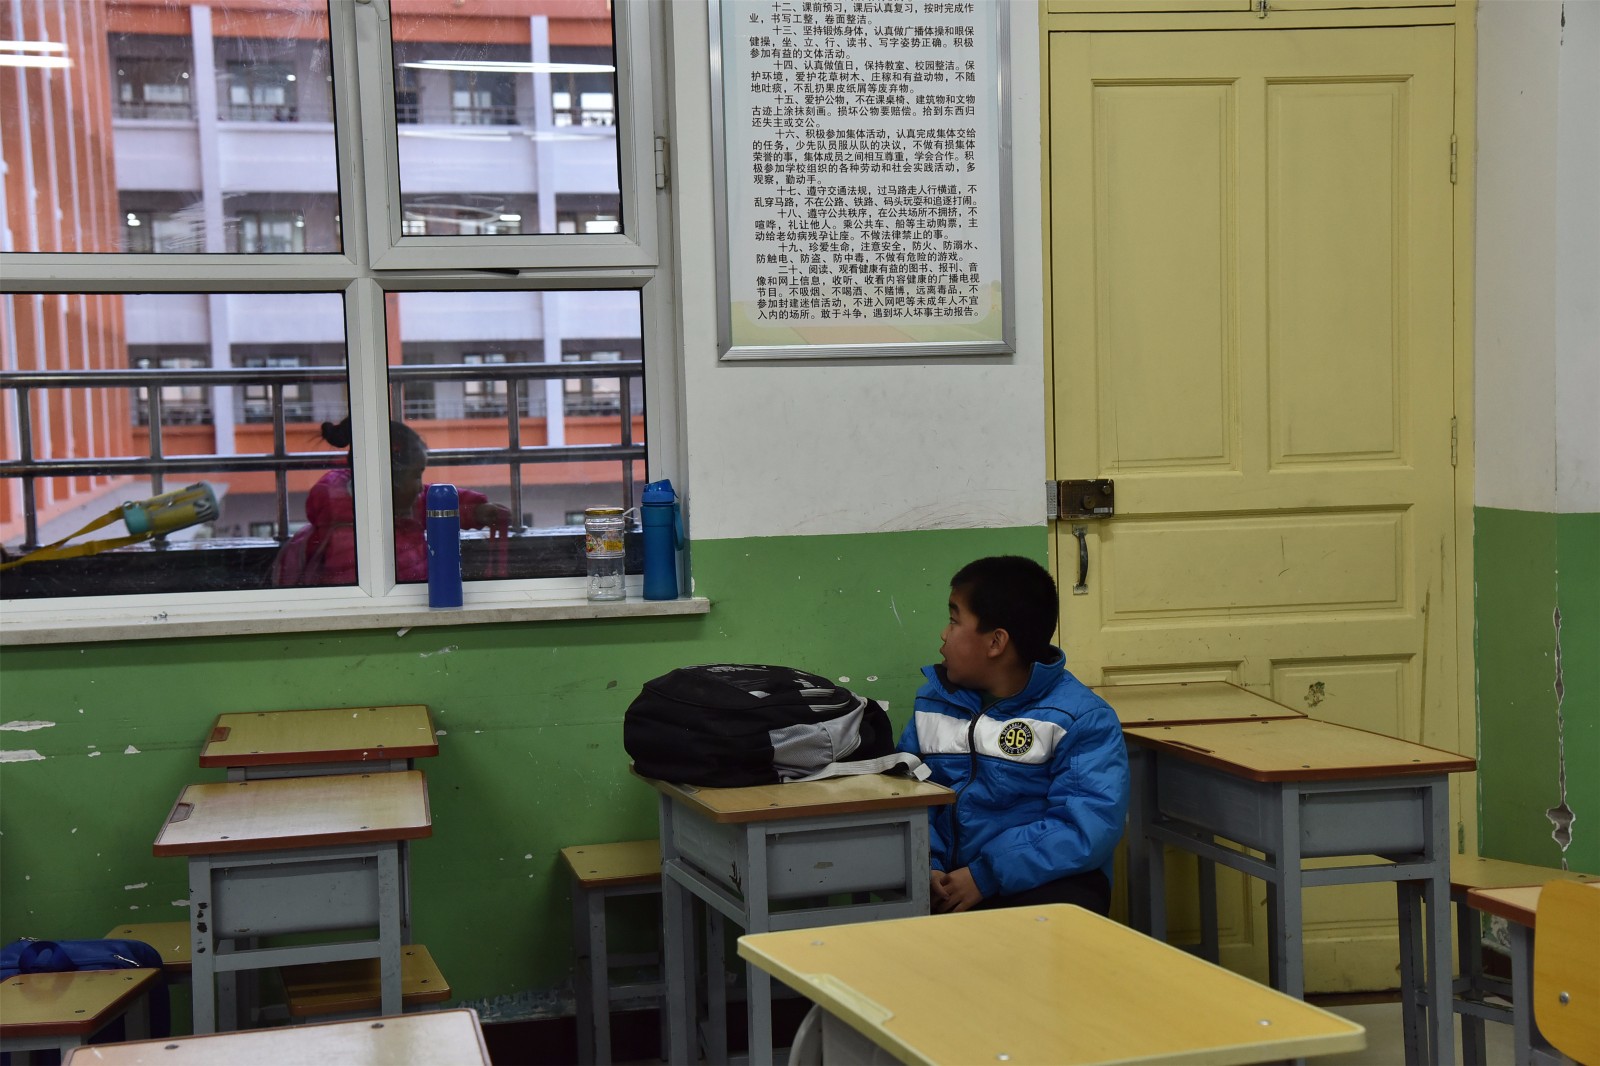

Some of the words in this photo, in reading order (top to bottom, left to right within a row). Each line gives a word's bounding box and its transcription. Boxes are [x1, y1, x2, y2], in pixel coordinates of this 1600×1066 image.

[772, 2, 974, 13] 十二、课前预习，课后认真复习，按时完成作
[749, 13, 873, 25] 业，书写工整，卷面整洁。
[772, 25, 974, 36] 十三、坚持锻炼身体，认真做广播体操和眼保
[749, 36, 974, 48] 健操，坐、立、行、读书、写字姿势正确。积极
[750, 48, 851, 59] 参加有益的文体活动。
[773, 60, 975, 71] 十四、认真做值日，保持教室、校园整洁。保
[751, 71, 976, 82] 护环境，爱护花草树木、庄稼和有益动物，不随
[751, 82, 914, 94] 地吐痰，不乱扔果皮纸屑等废弃物。
[774, 94, 976, 105] 十五、爱护公物，不在课桌椅、建筑物和文物
[752, 105, 975, 117] 古迹上涂抹刻画。损坏公物要赔偿。拾到东西归
[752, 117, 821, 128] 还失主或交公。
[775, 128, 976, 140] 十六、积极参加集体活动，认真完成集体交给
[752, 140, 976, 151] 的任务，少先队员服从队的决议，不做有损集体
[753, 151, 975, 162] 荣誉的事，集体成员之间相互尊重，学会合作。积
[753, 162, 976, 173] 极参加学校组织的各种劳动和社会实践活动，多
[753, 174, 822, 185] 观察，勤动手。
[777, 184, 978, 196] 十七、遵守交通法规，过马路走人行横道，不
[754, 195, 977, 207] 乱穿马路，不在公路、铁路、码头玩耍和追逐打闹。
[777, 207, 978, 219] 十八、遵守公共秩序，在公共场所不拥挤，不
[755, 218, 978, 230] 喧哗，礼让他人。乘公共车、船等主动购票，主
[755, 230, 949, 241] 动给老幼病残孕让座。不做法律禁止的事。
[778, 240, 979, 252] 十九、珍爱生命，注意安全，防火、防溺水、
[756, 252, 963, 264] 防触电、防盗、防中毒，不做有危险的游戏。
[778, 262, 978, 274] 二十、阅读、观看健康有益的图书、报刊、音
[756, 273, 980, 286] 像和网上信息，收听、收看内容健康的广播电视
[757, 285, 979, 297] 节目。不吸烟、不喝酒、不赌博，远离毒品，不
[757, 296, 979, 308] 参加封建迷信活动，不进入网吧等未成年人不宜
[757, 307, 978, 320] 入内的场所。敢于斗争，遇到坏人坏事主动报告。
[1006, 729, 1026, 748] 96
